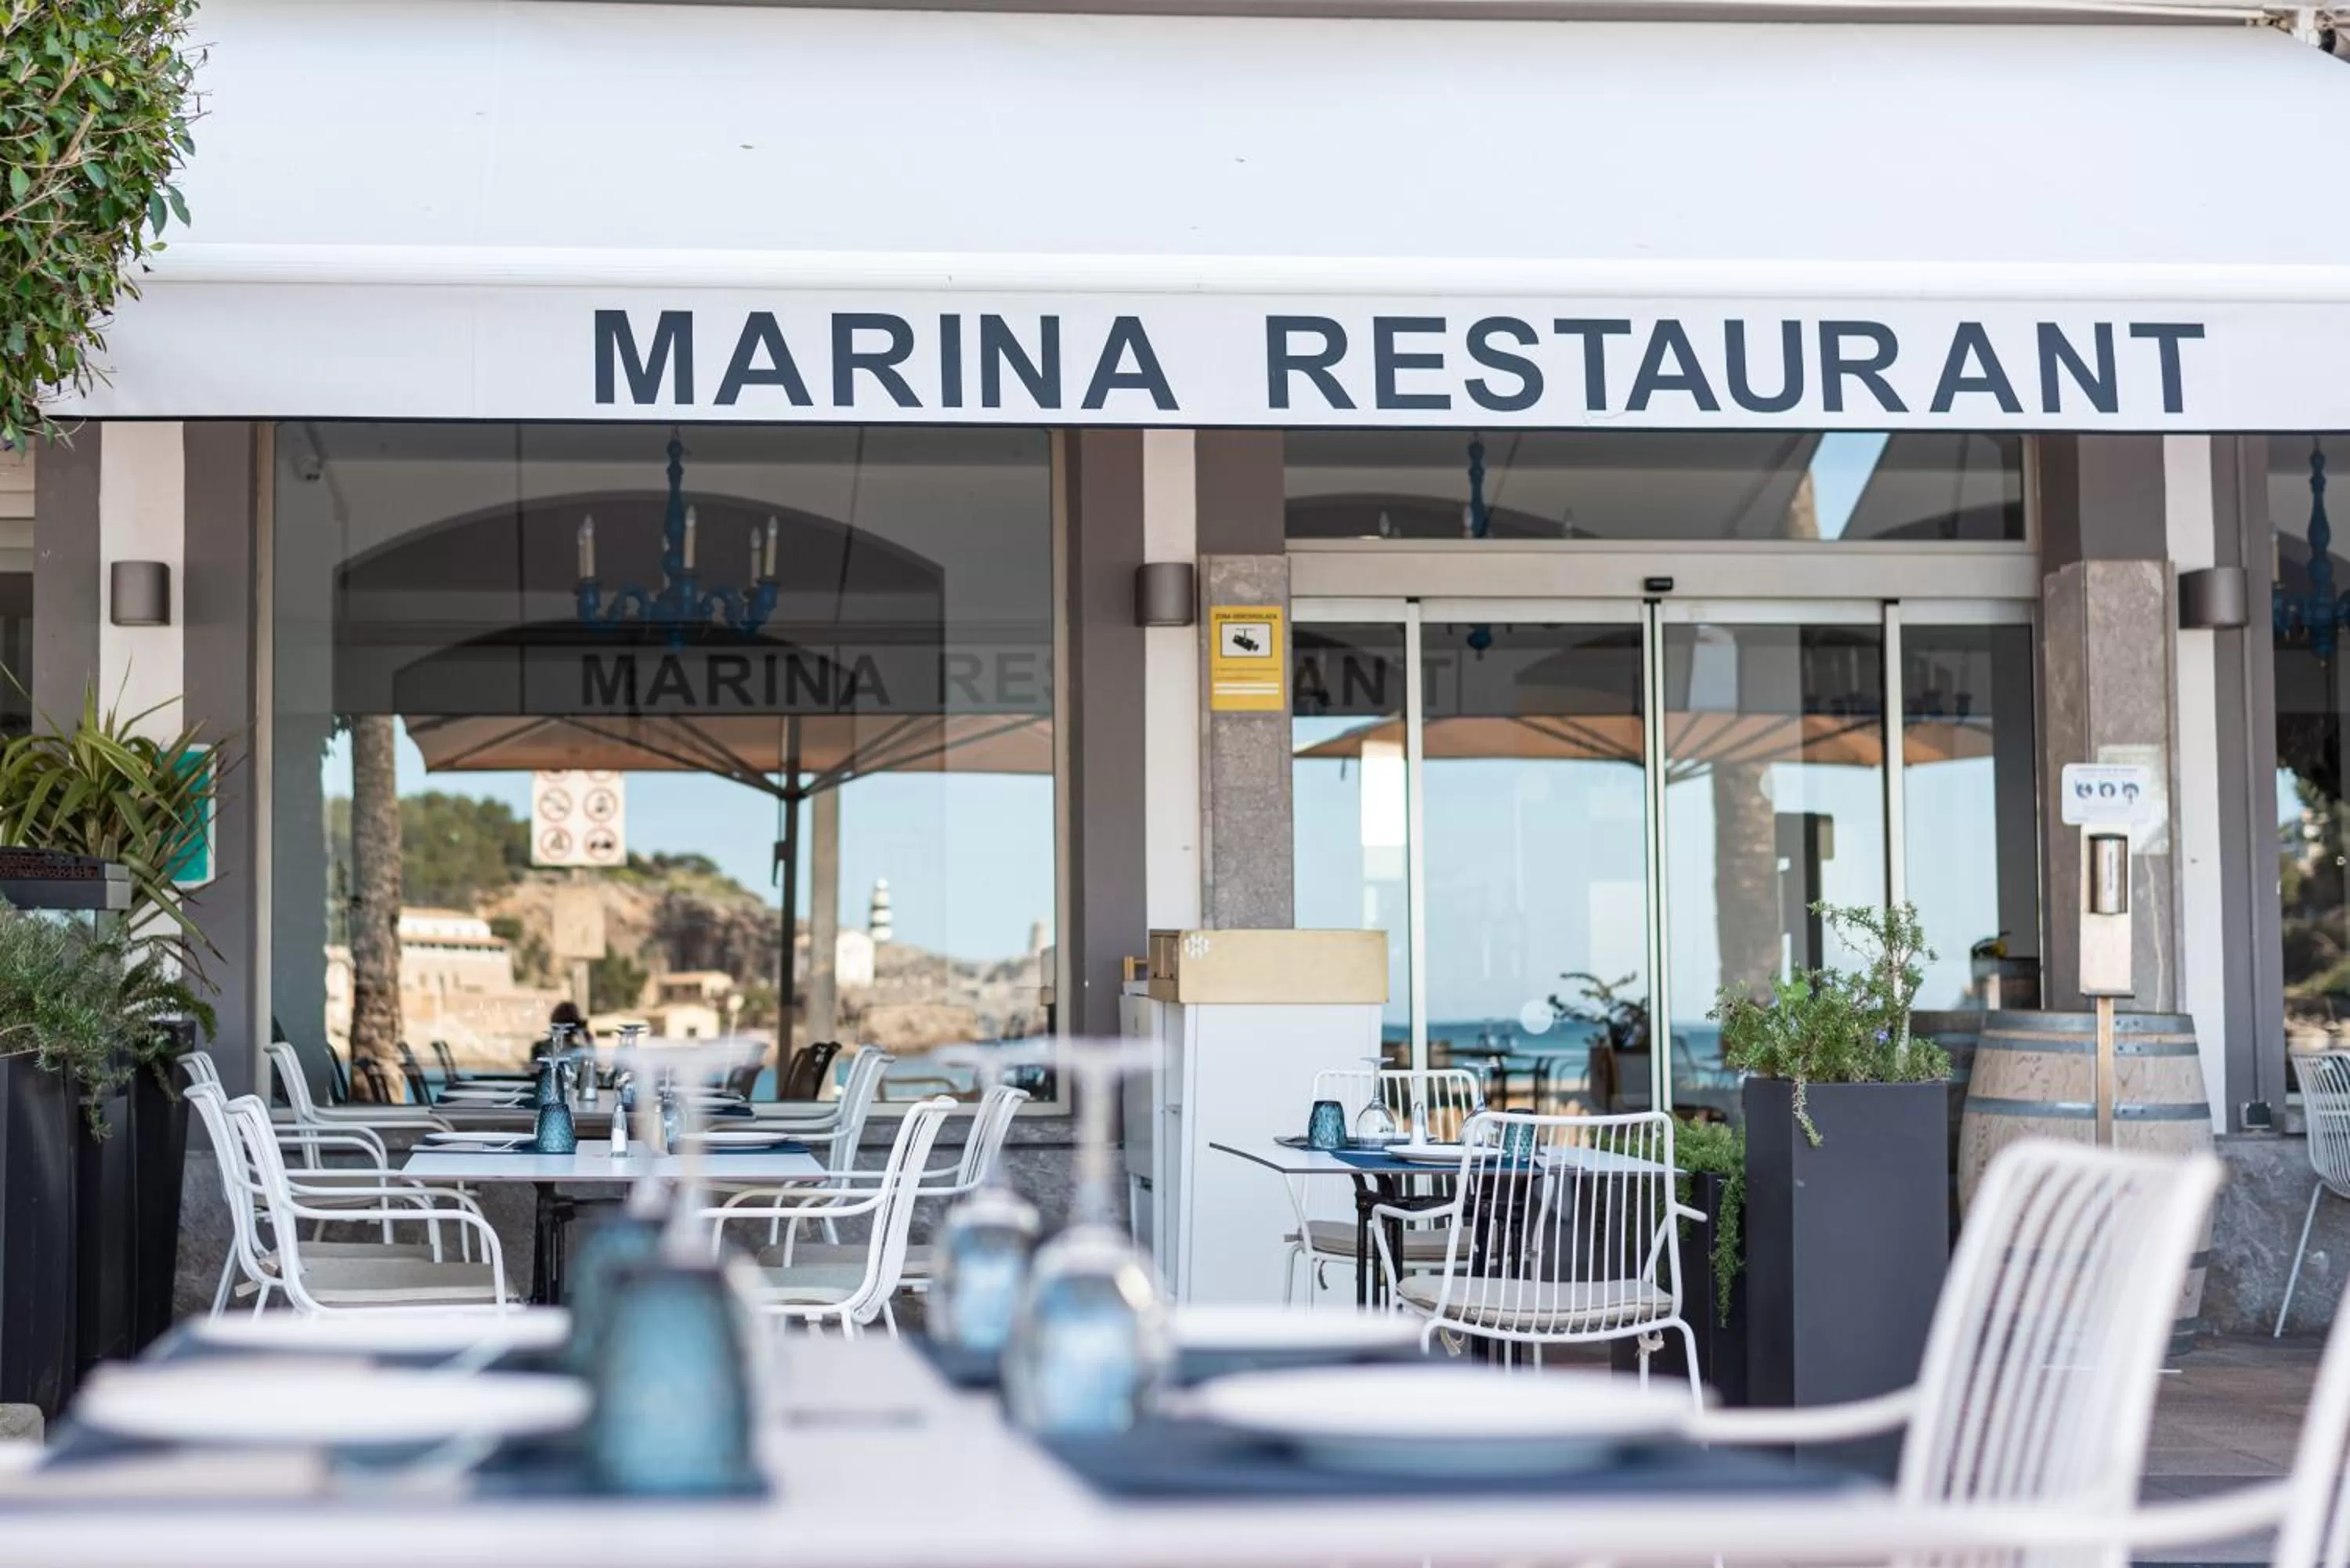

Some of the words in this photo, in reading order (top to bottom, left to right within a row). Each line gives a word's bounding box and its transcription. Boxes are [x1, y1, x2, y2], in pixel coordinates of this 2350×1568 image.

[595, 309, 1180, 410] MARINA
[1265, 315, 2206, 414] RESTAURANT
[582, 654, 891, 706] MARINA
